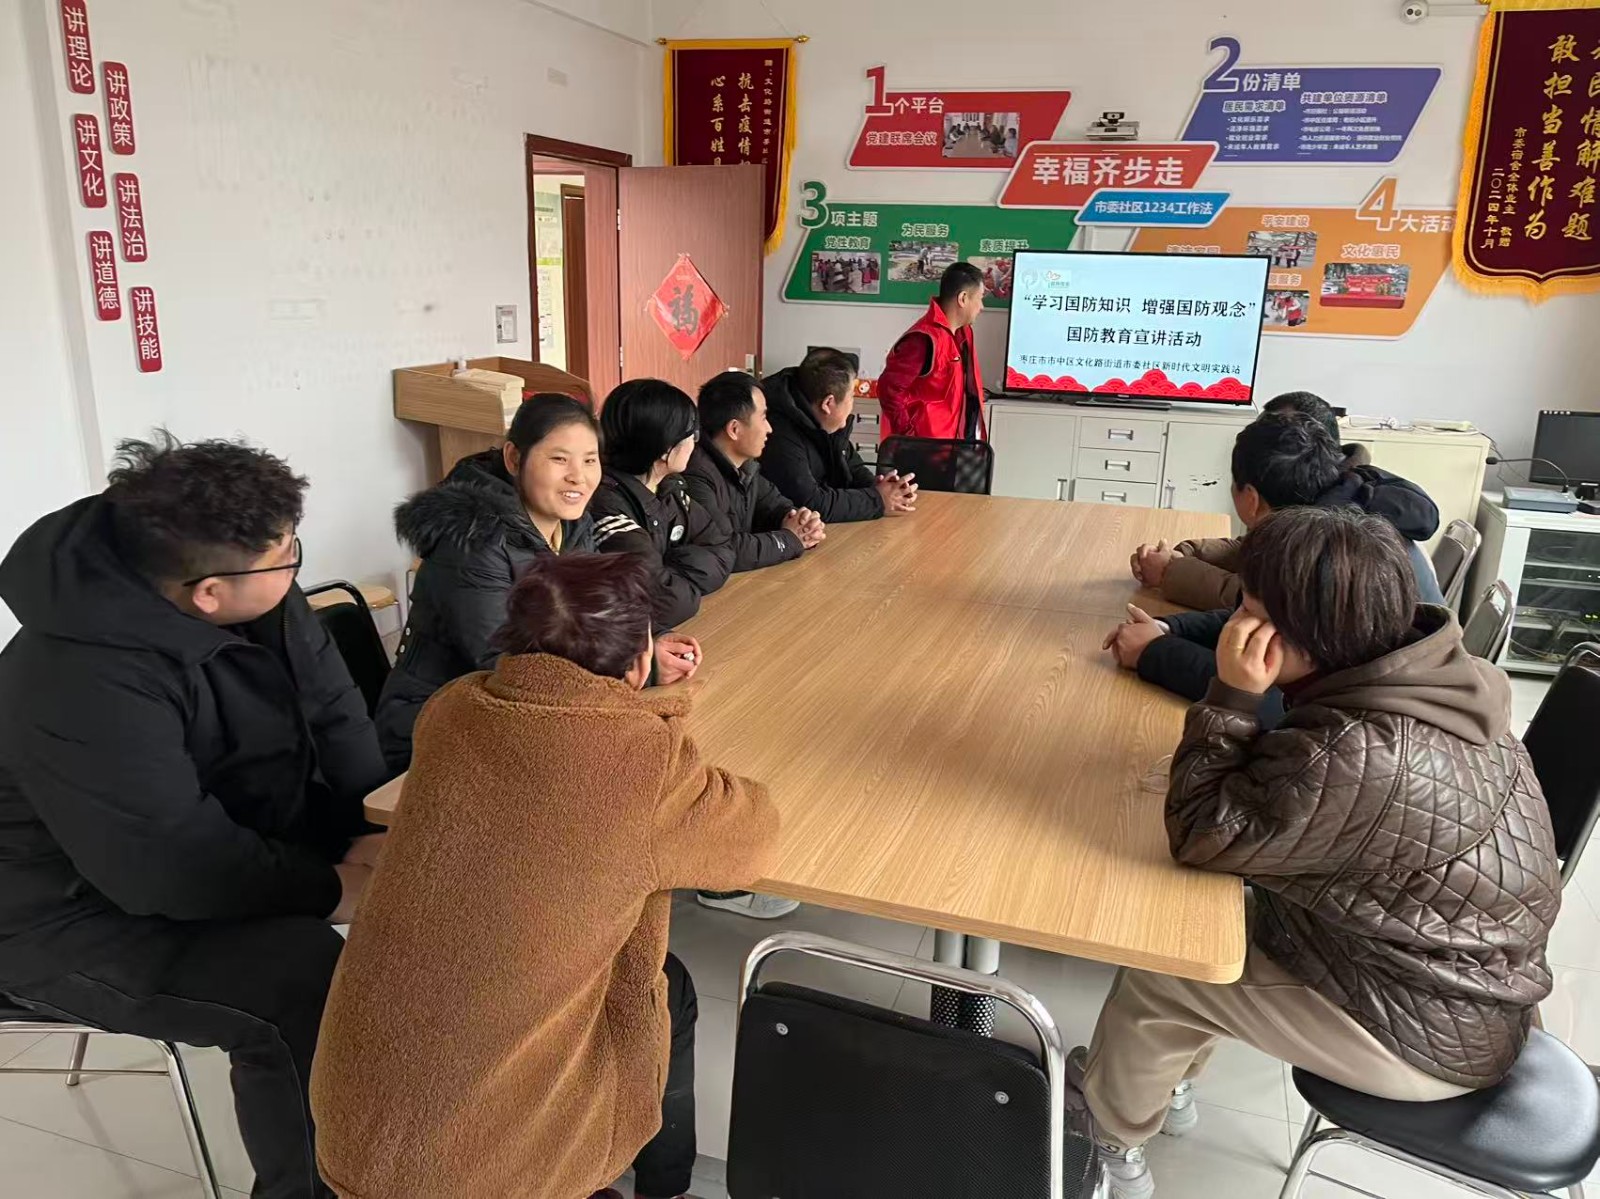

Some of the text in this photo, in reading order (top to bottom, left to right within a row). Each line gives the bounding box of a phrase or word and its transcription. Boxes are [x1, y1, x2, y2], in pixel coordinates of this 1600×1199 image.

[64, 6, 92, 87] 讲理论
[106, 69, 133, 147] 讲政策
[866, 132, 937, 146] 党建联席会议
[1524, 34, 1580, 240] 敢担当善作为
[77, 120, 104, 197] 讲文化
[1032, 156, 1184, 186] 幸福齐步走
[118, 180, 145, 257] 讲法治
[1094, 201, 1213, 215] 市委社区1234工作法
[1261, 215, 1310, 228] 平安建设
[825, 236, 871, 250] 党性教育
[902, 223, 949, 238] 为民服务
[1341, 243, 1400, 259] 文化惠民
[92, 236, 119, 309] 讲道德
[668, 284, 699, 336] 福
[1024, 294, 1256, 318] “学习国防知识 增强国防观念”
[134, 289, 159, 360] 讲技能
[1067, 326, 1202, 347] 国防教育宣讲活动
